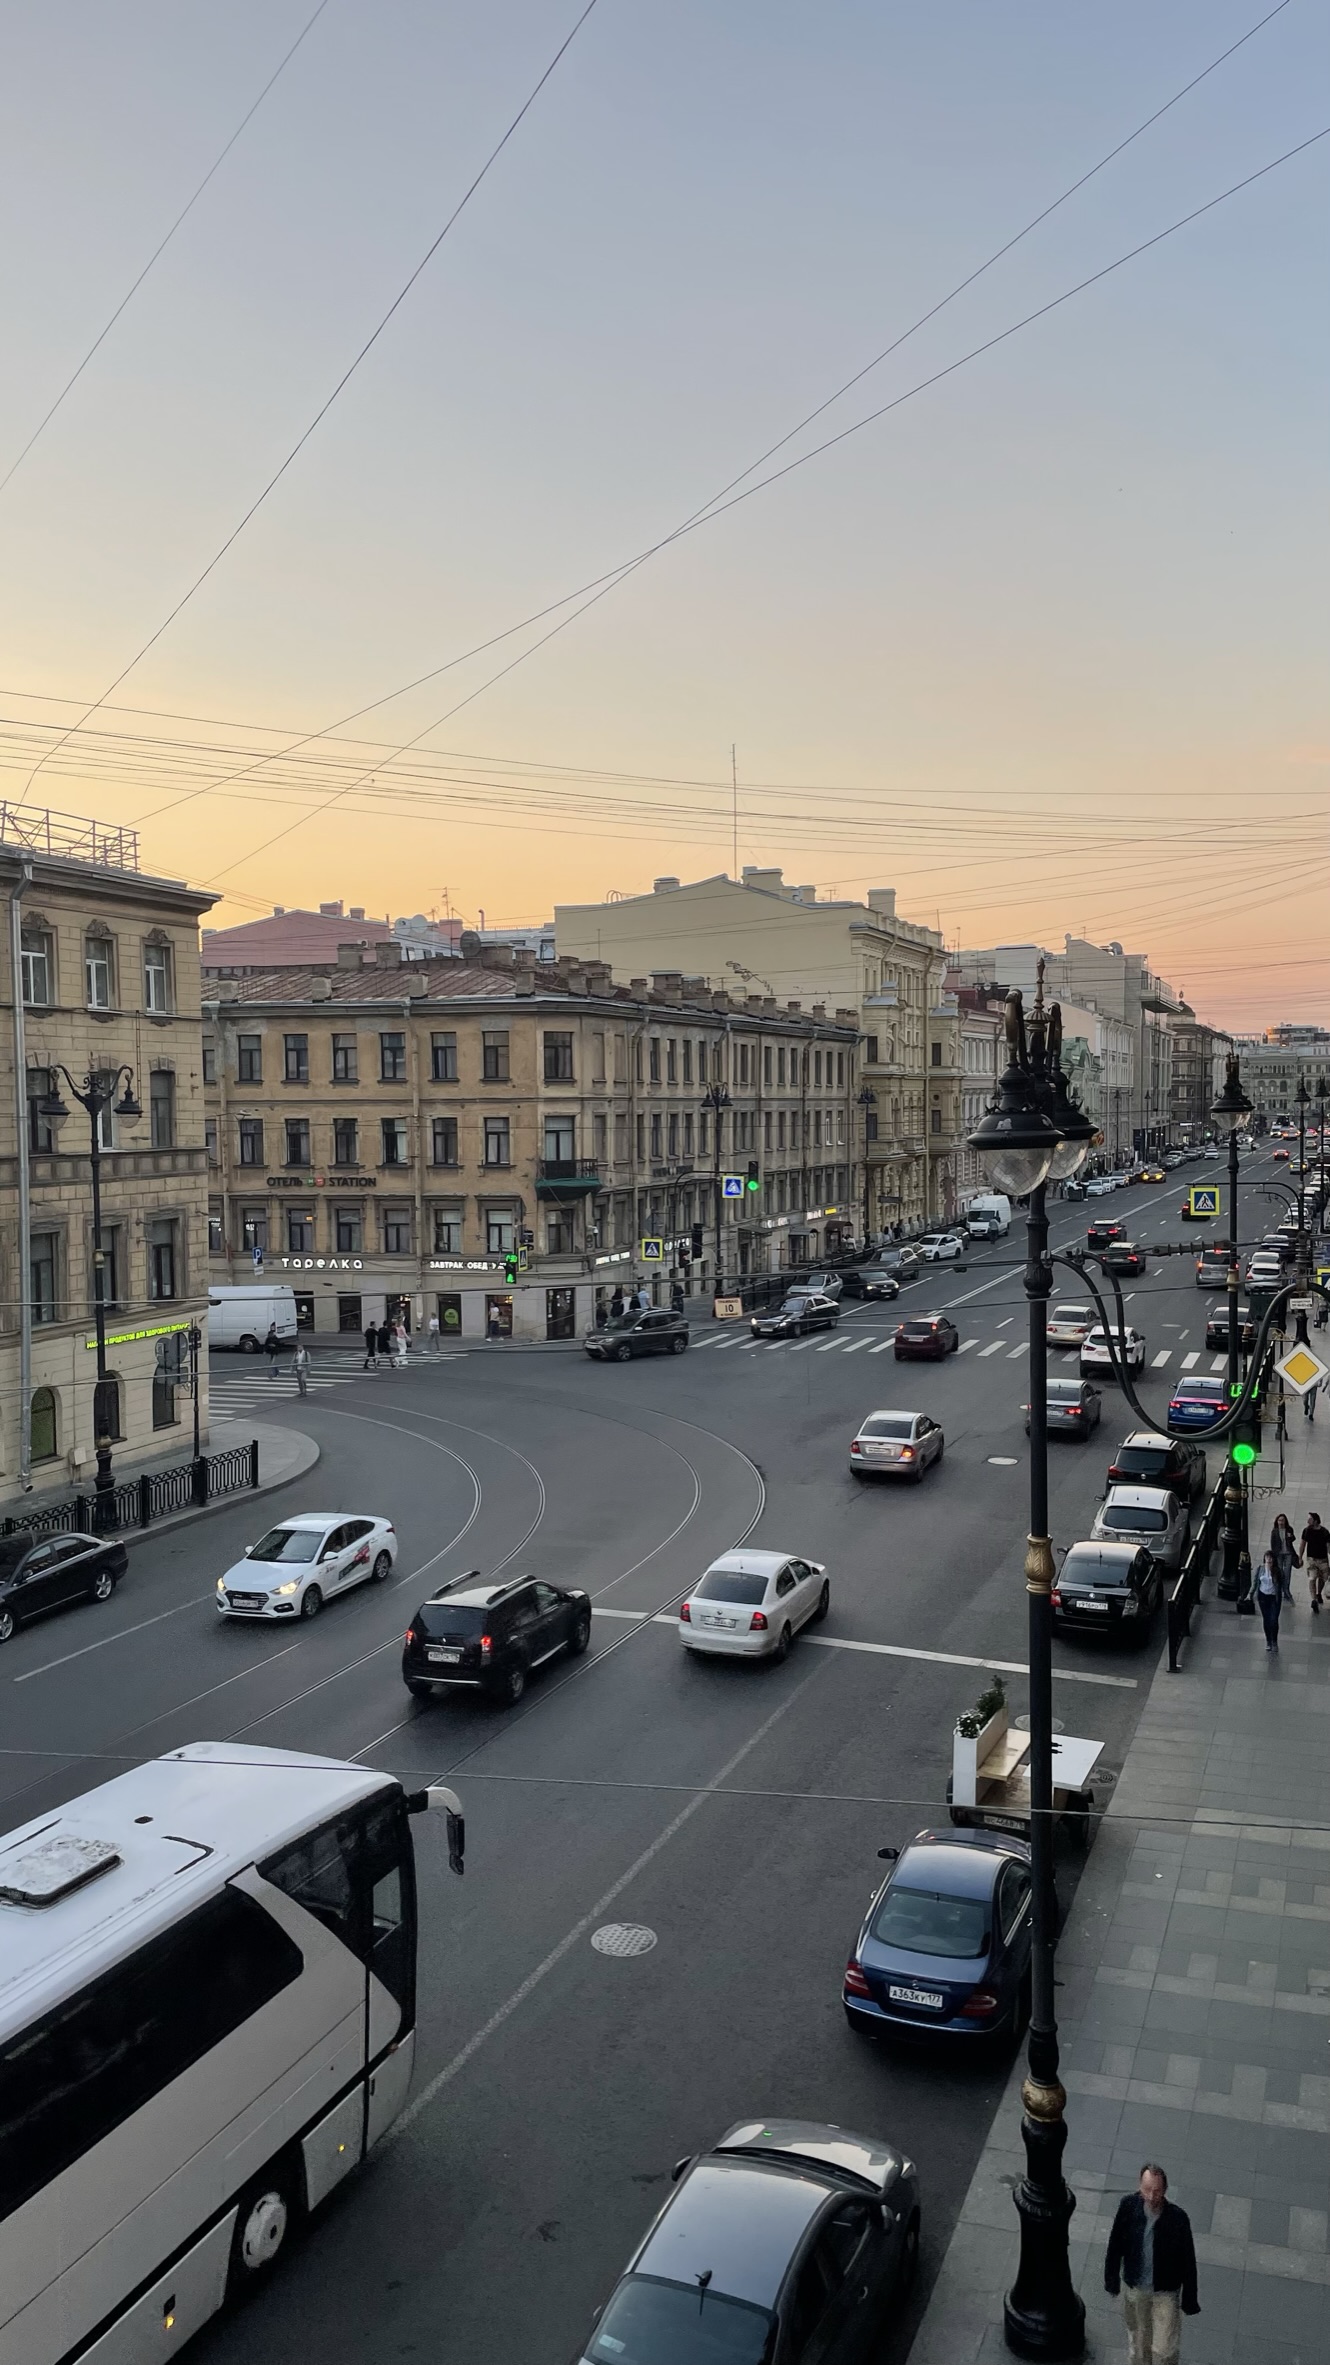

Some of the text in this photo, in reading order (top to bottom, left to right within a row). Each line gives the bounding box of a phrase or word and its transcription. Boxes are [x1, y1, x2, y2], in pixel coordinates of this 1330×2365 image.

[266, 1177, 303, 1187] ОТЕЛЬ
[329, 1177, 377, 1187] STATION
[429, 1261, 464, 1269] ЗАВТРАК
[467, 1262, 488, 1271] ОБЕД
[724, 1304, 734, 1313] 10
